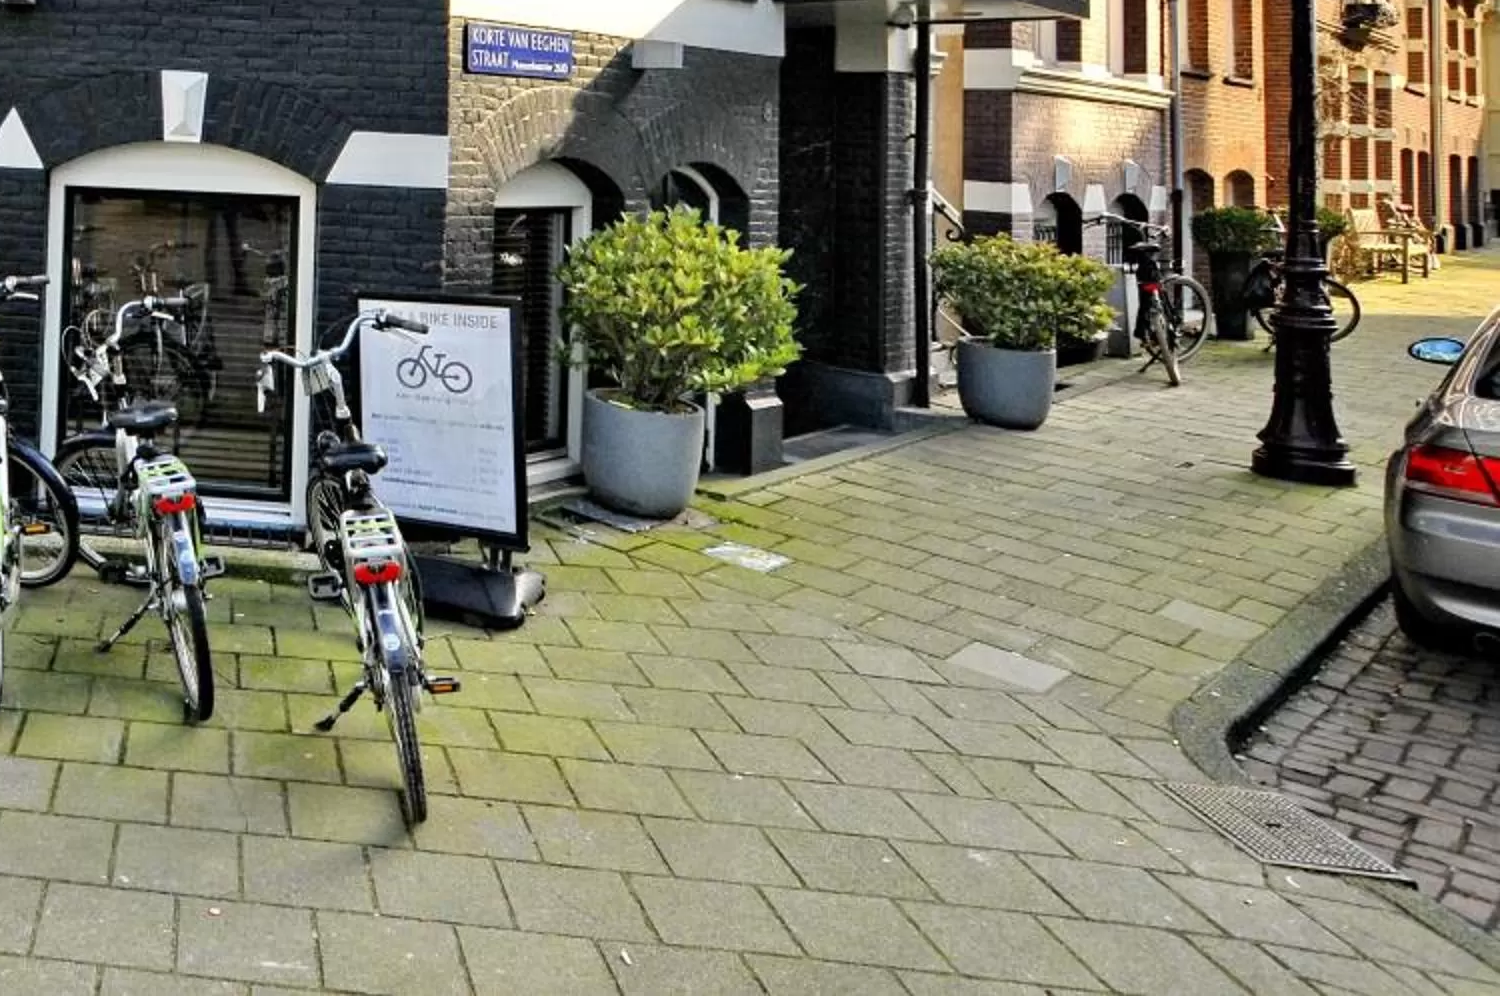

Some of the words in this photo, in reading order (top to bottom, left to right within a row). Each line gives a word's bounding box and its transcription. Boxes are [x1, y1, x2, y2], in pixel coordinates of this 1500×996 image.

[472, 27, 506, 47] KORTE
[507, 30, 529, 49] VAN
[531, 34, 570, 53] EEGHEN
[472, 49, 509, 69] STRAAT
[420, 311, 450, 326] BIKE
[453, 313, 498, 330] INSIDE
